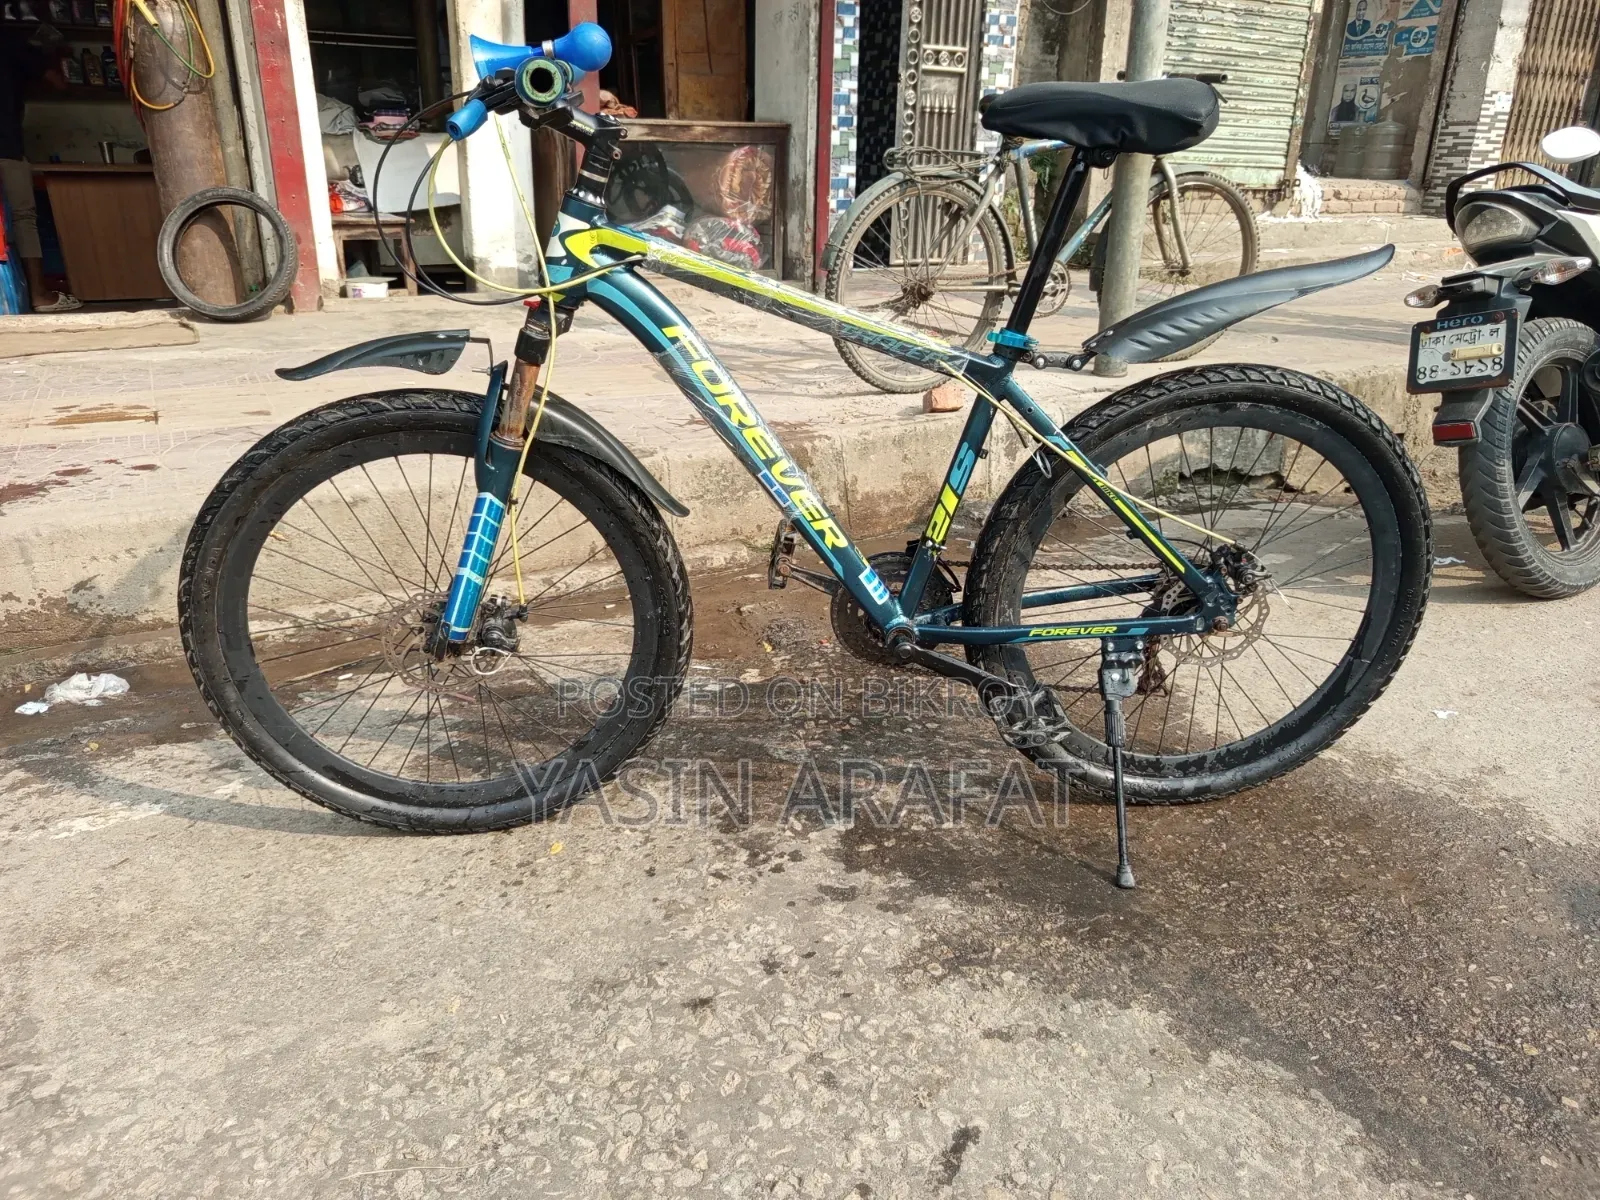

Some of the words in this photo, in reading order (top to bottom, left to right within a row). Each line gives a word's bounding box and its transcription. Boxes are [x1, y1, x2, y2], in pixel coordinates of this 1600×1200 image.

[1420, 332, 1446, 348] ঢাকা
[662, 326, 849, 549] FOREVER
[1027, 625, 1118, 637] FOREVER
